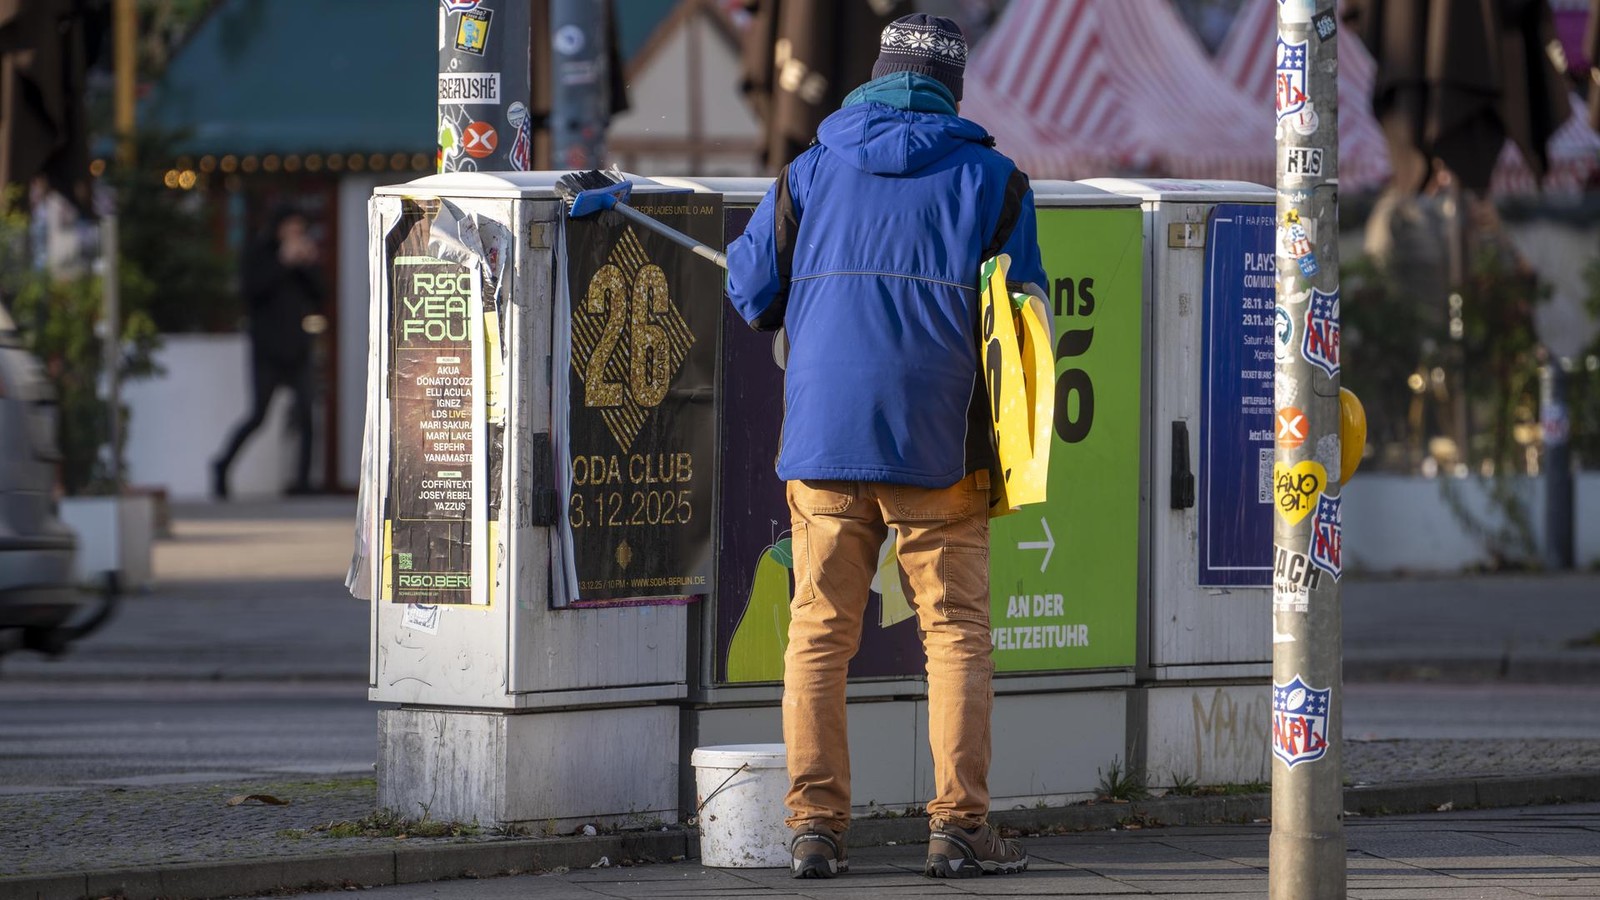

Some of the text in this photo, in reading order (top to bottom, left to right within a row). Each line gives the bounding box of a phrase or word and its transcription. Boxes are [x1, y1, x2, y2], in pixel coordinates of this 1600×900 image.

[700, 206, 714, 214] AM
[1235, 216, 1243, 225] IT
[404, 297, 472, 318] YEA
[404, 320, 472, 341] FOU
[585, 264, 671, 407] 26
[656, 341, 667, 387] YEARS
[437, 366, 460, 375] AKUA
[417, 377, 451, 386] DONATO
[426, 388, 471, 397] ELLI ACULA
[437, 399, 461, 408] IGNEZ
[432, 410, 466, 419] LDS LIVE
[420, 421, 441, 430] MARI
[427, 431, 472, 440] MARY LAKE
[434, 443, 465, 452] SEPEHR
[572, 452, 693, 486] ODA CLUB
[418, 490, 446, 500] JOSEY
[435, 501, 466, 511] YAZZUS
[570, 490, 693, 528] 3.12.2025
[399, 575, 472, 587] RSO.BER
[579, 581, 603, 591] 3.12.25
[1006, 594, 1064, 618] AN DER
